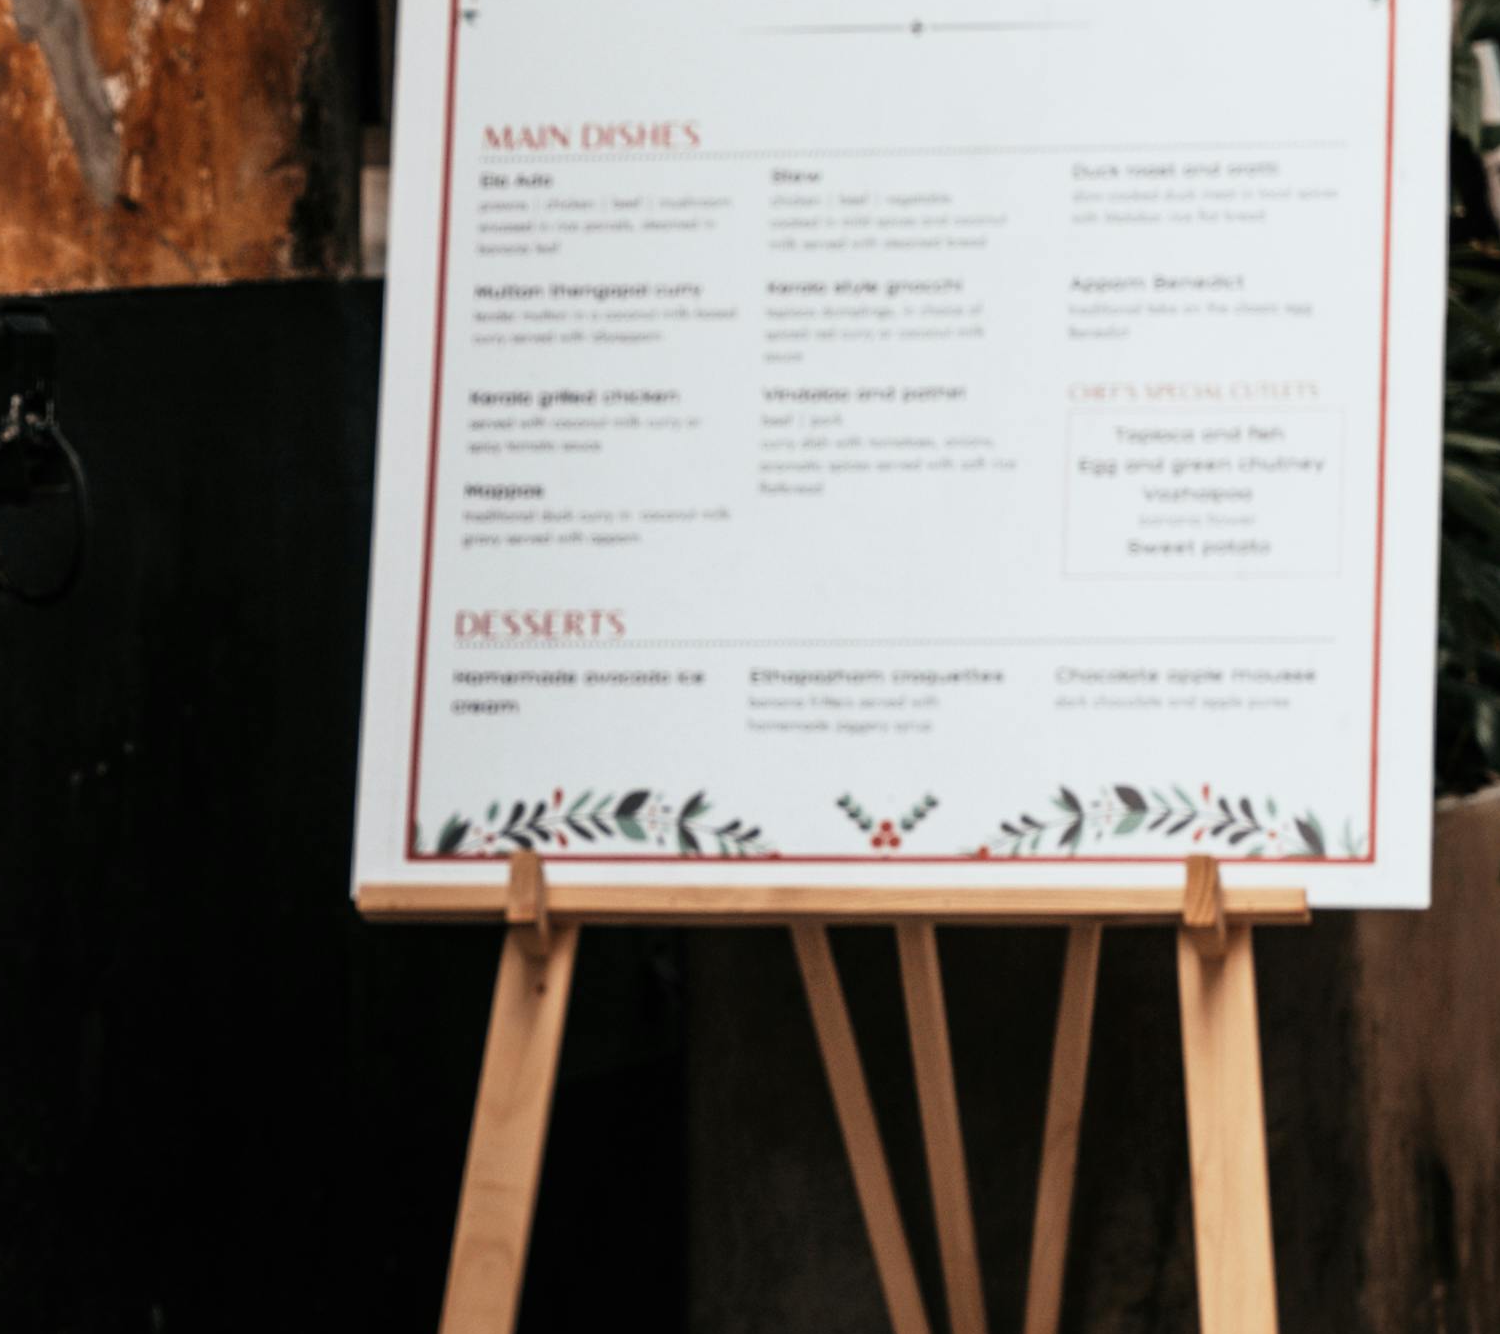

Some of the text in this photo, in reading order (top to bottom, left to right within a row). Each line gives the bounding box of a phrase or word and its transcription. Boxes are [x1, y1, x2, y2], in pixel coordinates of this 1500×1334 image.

[482, 121, 702, 153] MAIN DISHES
[454, 610, 627, 639] DESSERTS
[452, 671, 578, 685] Homemade
[583, 671, 672, 685] avocado
